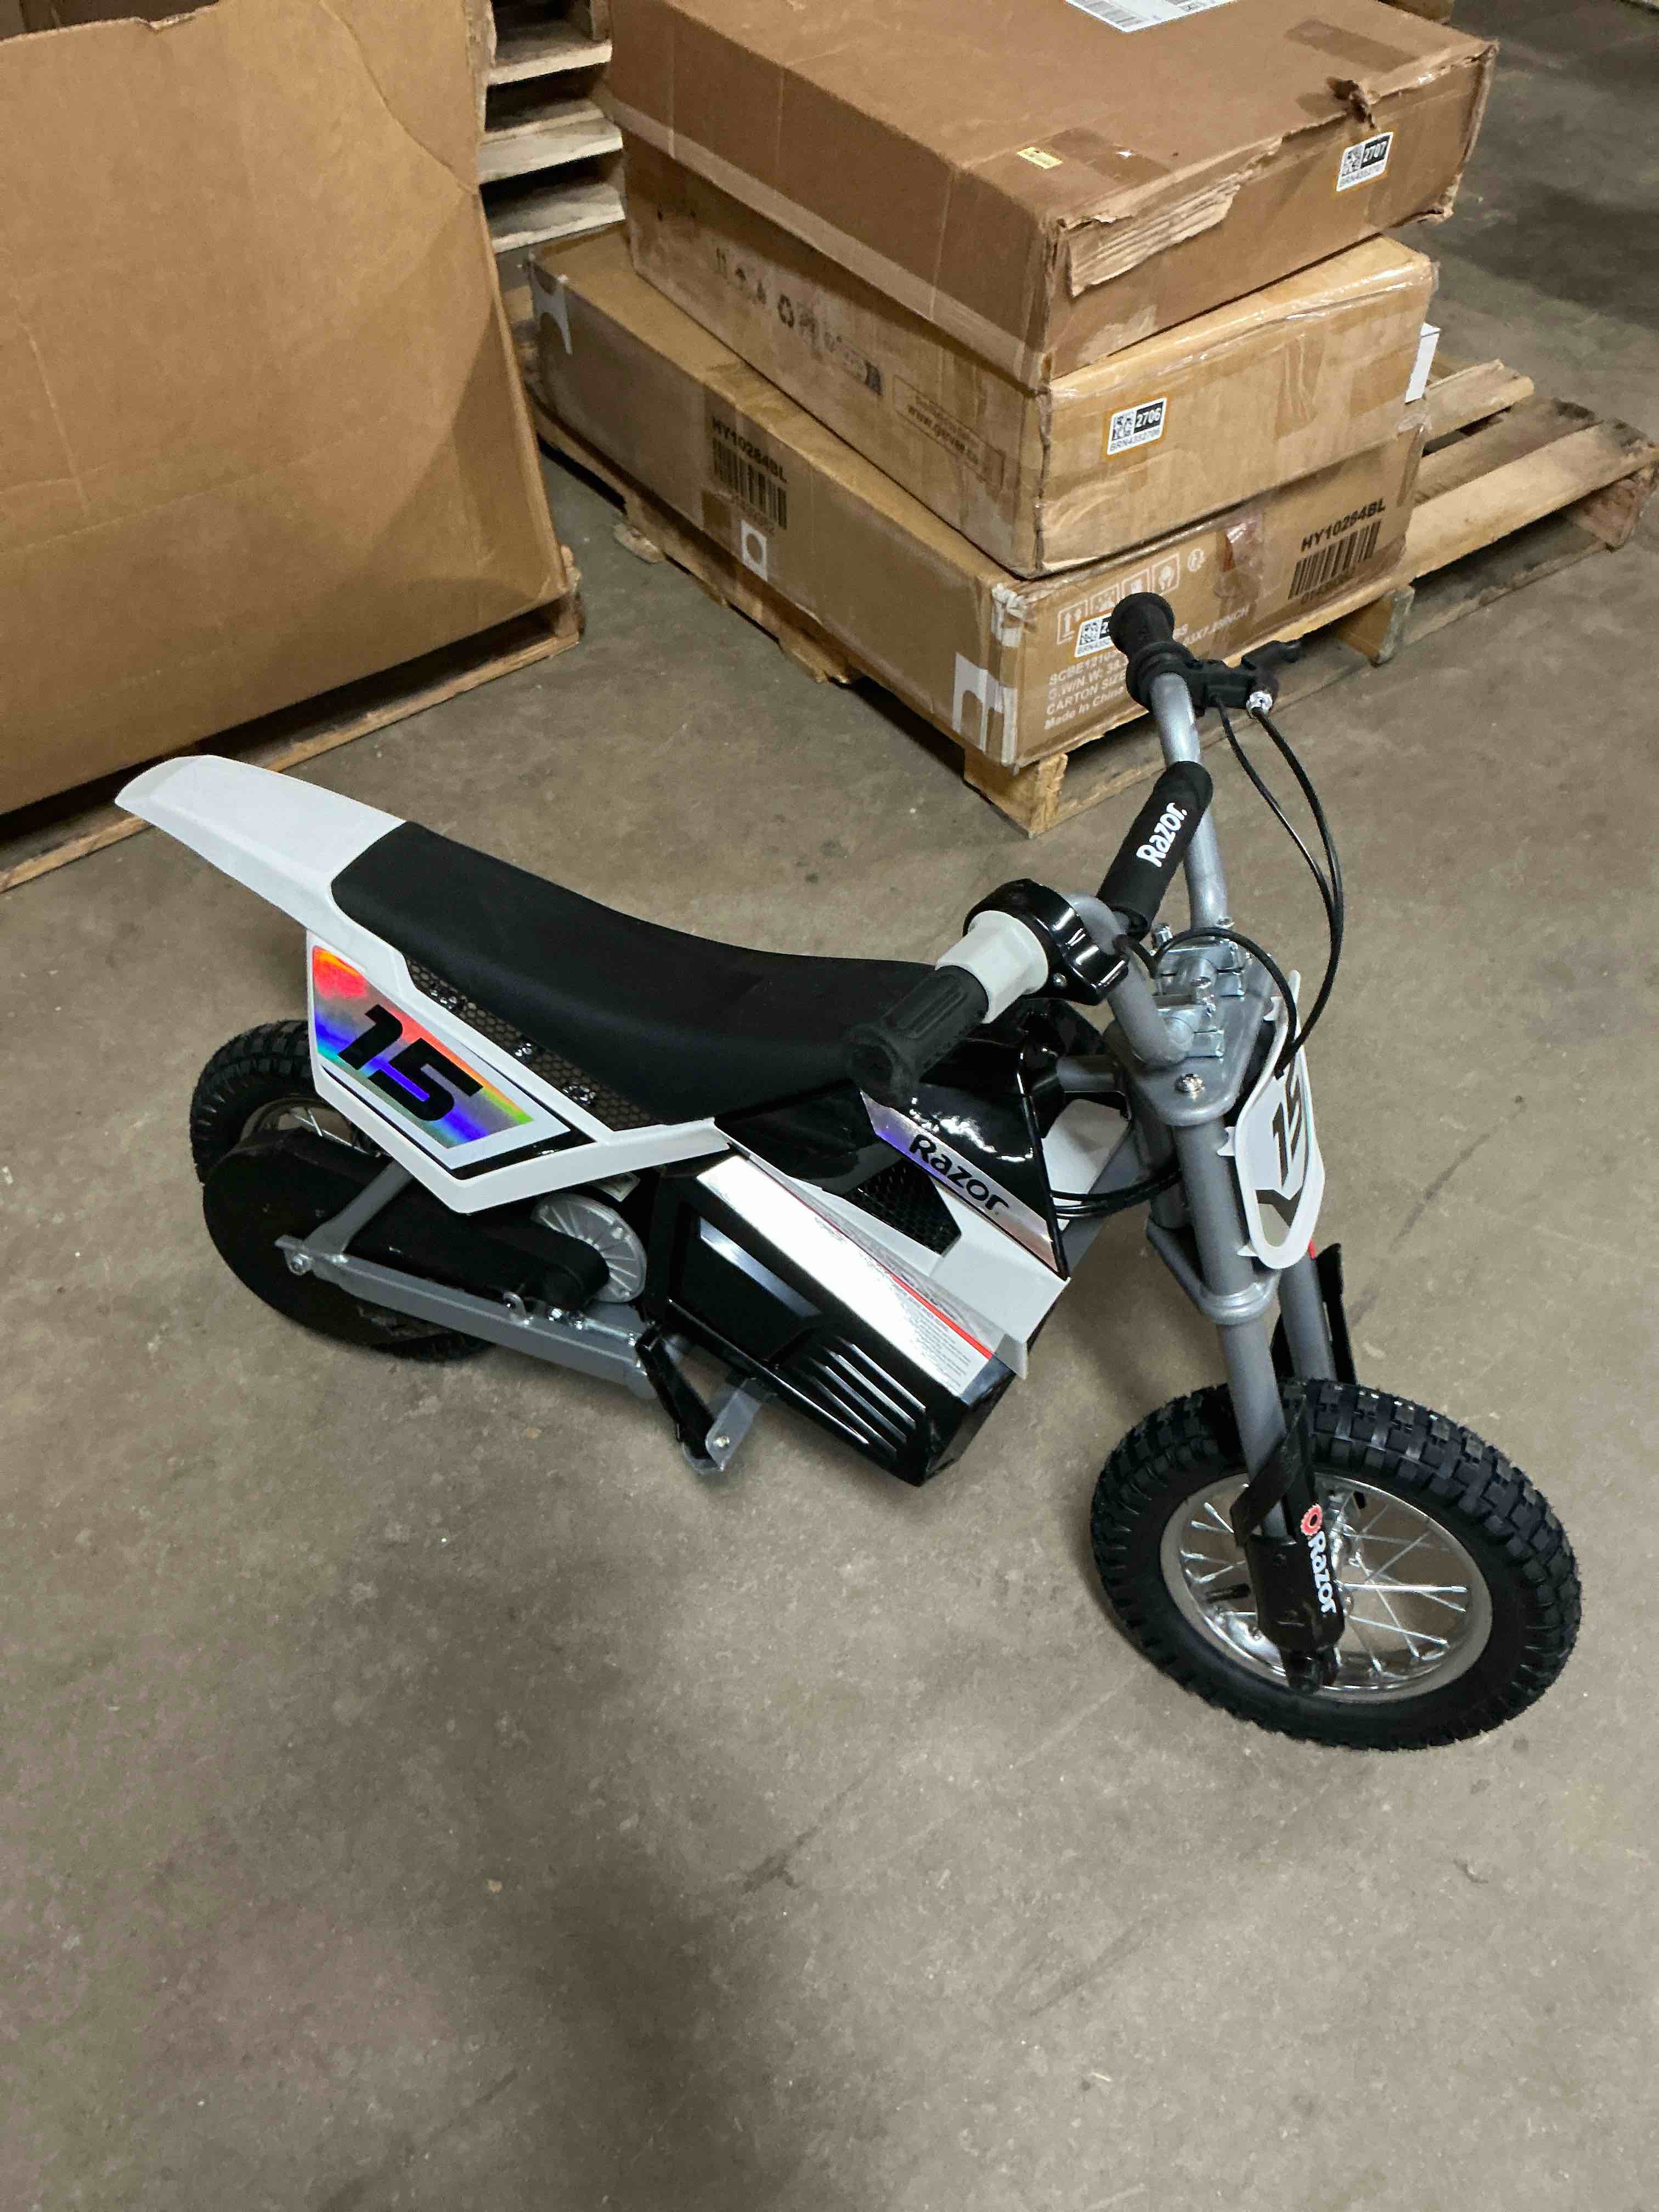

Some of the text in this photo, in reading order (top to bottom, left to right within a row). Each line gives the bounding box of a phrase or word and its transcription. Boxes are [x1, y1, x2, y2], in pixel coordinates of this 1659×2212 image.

[1136, 407, 1161, 427] 2706
[1045, 710, 1076, 730] Made
[1092, 686, 1125, 707] China
[1046, 686, 1098, 715] CARTON
[1136, 802, 1186, 867] Razor
[337, 1005, 484, 1121] 15
[909, 1133, 1009, 1210] Razor
[1308, 1531, 1336, 1613] Razor
